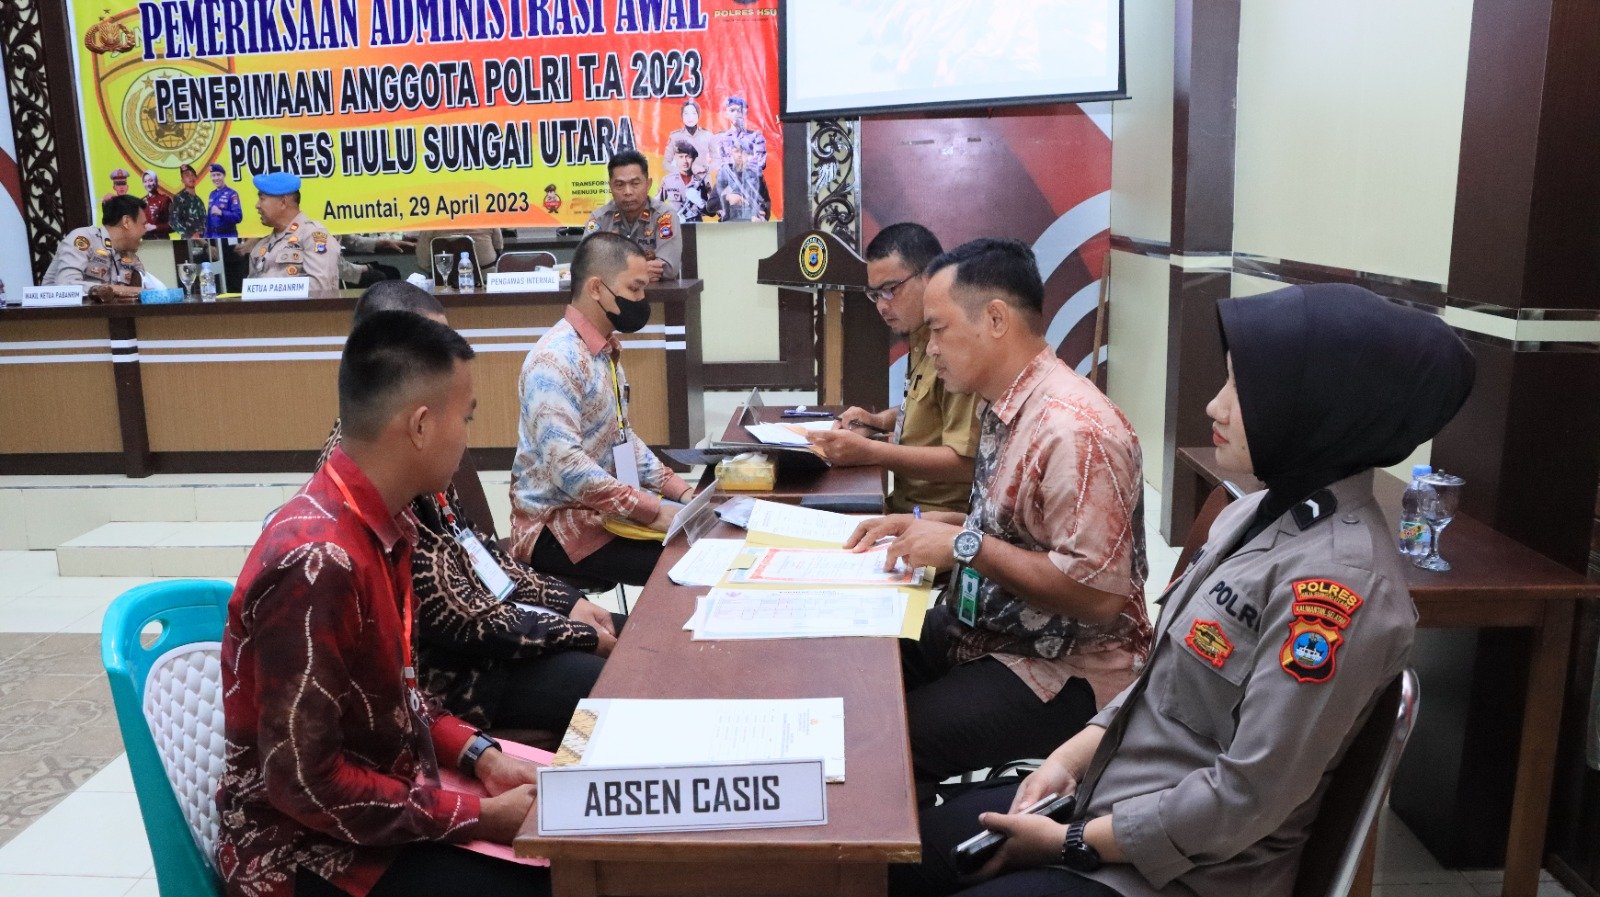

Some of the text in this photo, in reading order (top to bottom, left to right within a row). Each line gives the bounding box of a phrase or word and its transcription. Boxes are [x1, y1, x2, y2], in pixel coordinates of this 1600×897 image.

[714, 9, 754, 17] POLRES
[139, 0, 359, 60] PEMERIKSAAN
[370, 0, 606, 46] ADMINISTRASI
[615, 0, 707, 33] AWAL
[155, 49, 703, 122] PENERIMAAN ANGGOTA POLRI T.A 2023
[230, 116, 638, 181] POLRES HULU SUNGAI UTARA
[323, 191, 530, 220] Amuntai, 29 April 2023
[247, 283, 305, 293] KETUA PABANRIM
[491, 277, 525, 286] PENGAWAS
[1297, 581, 1358, 607] POLRES
[584, 775, 781, 817] ABSEN CASIS
